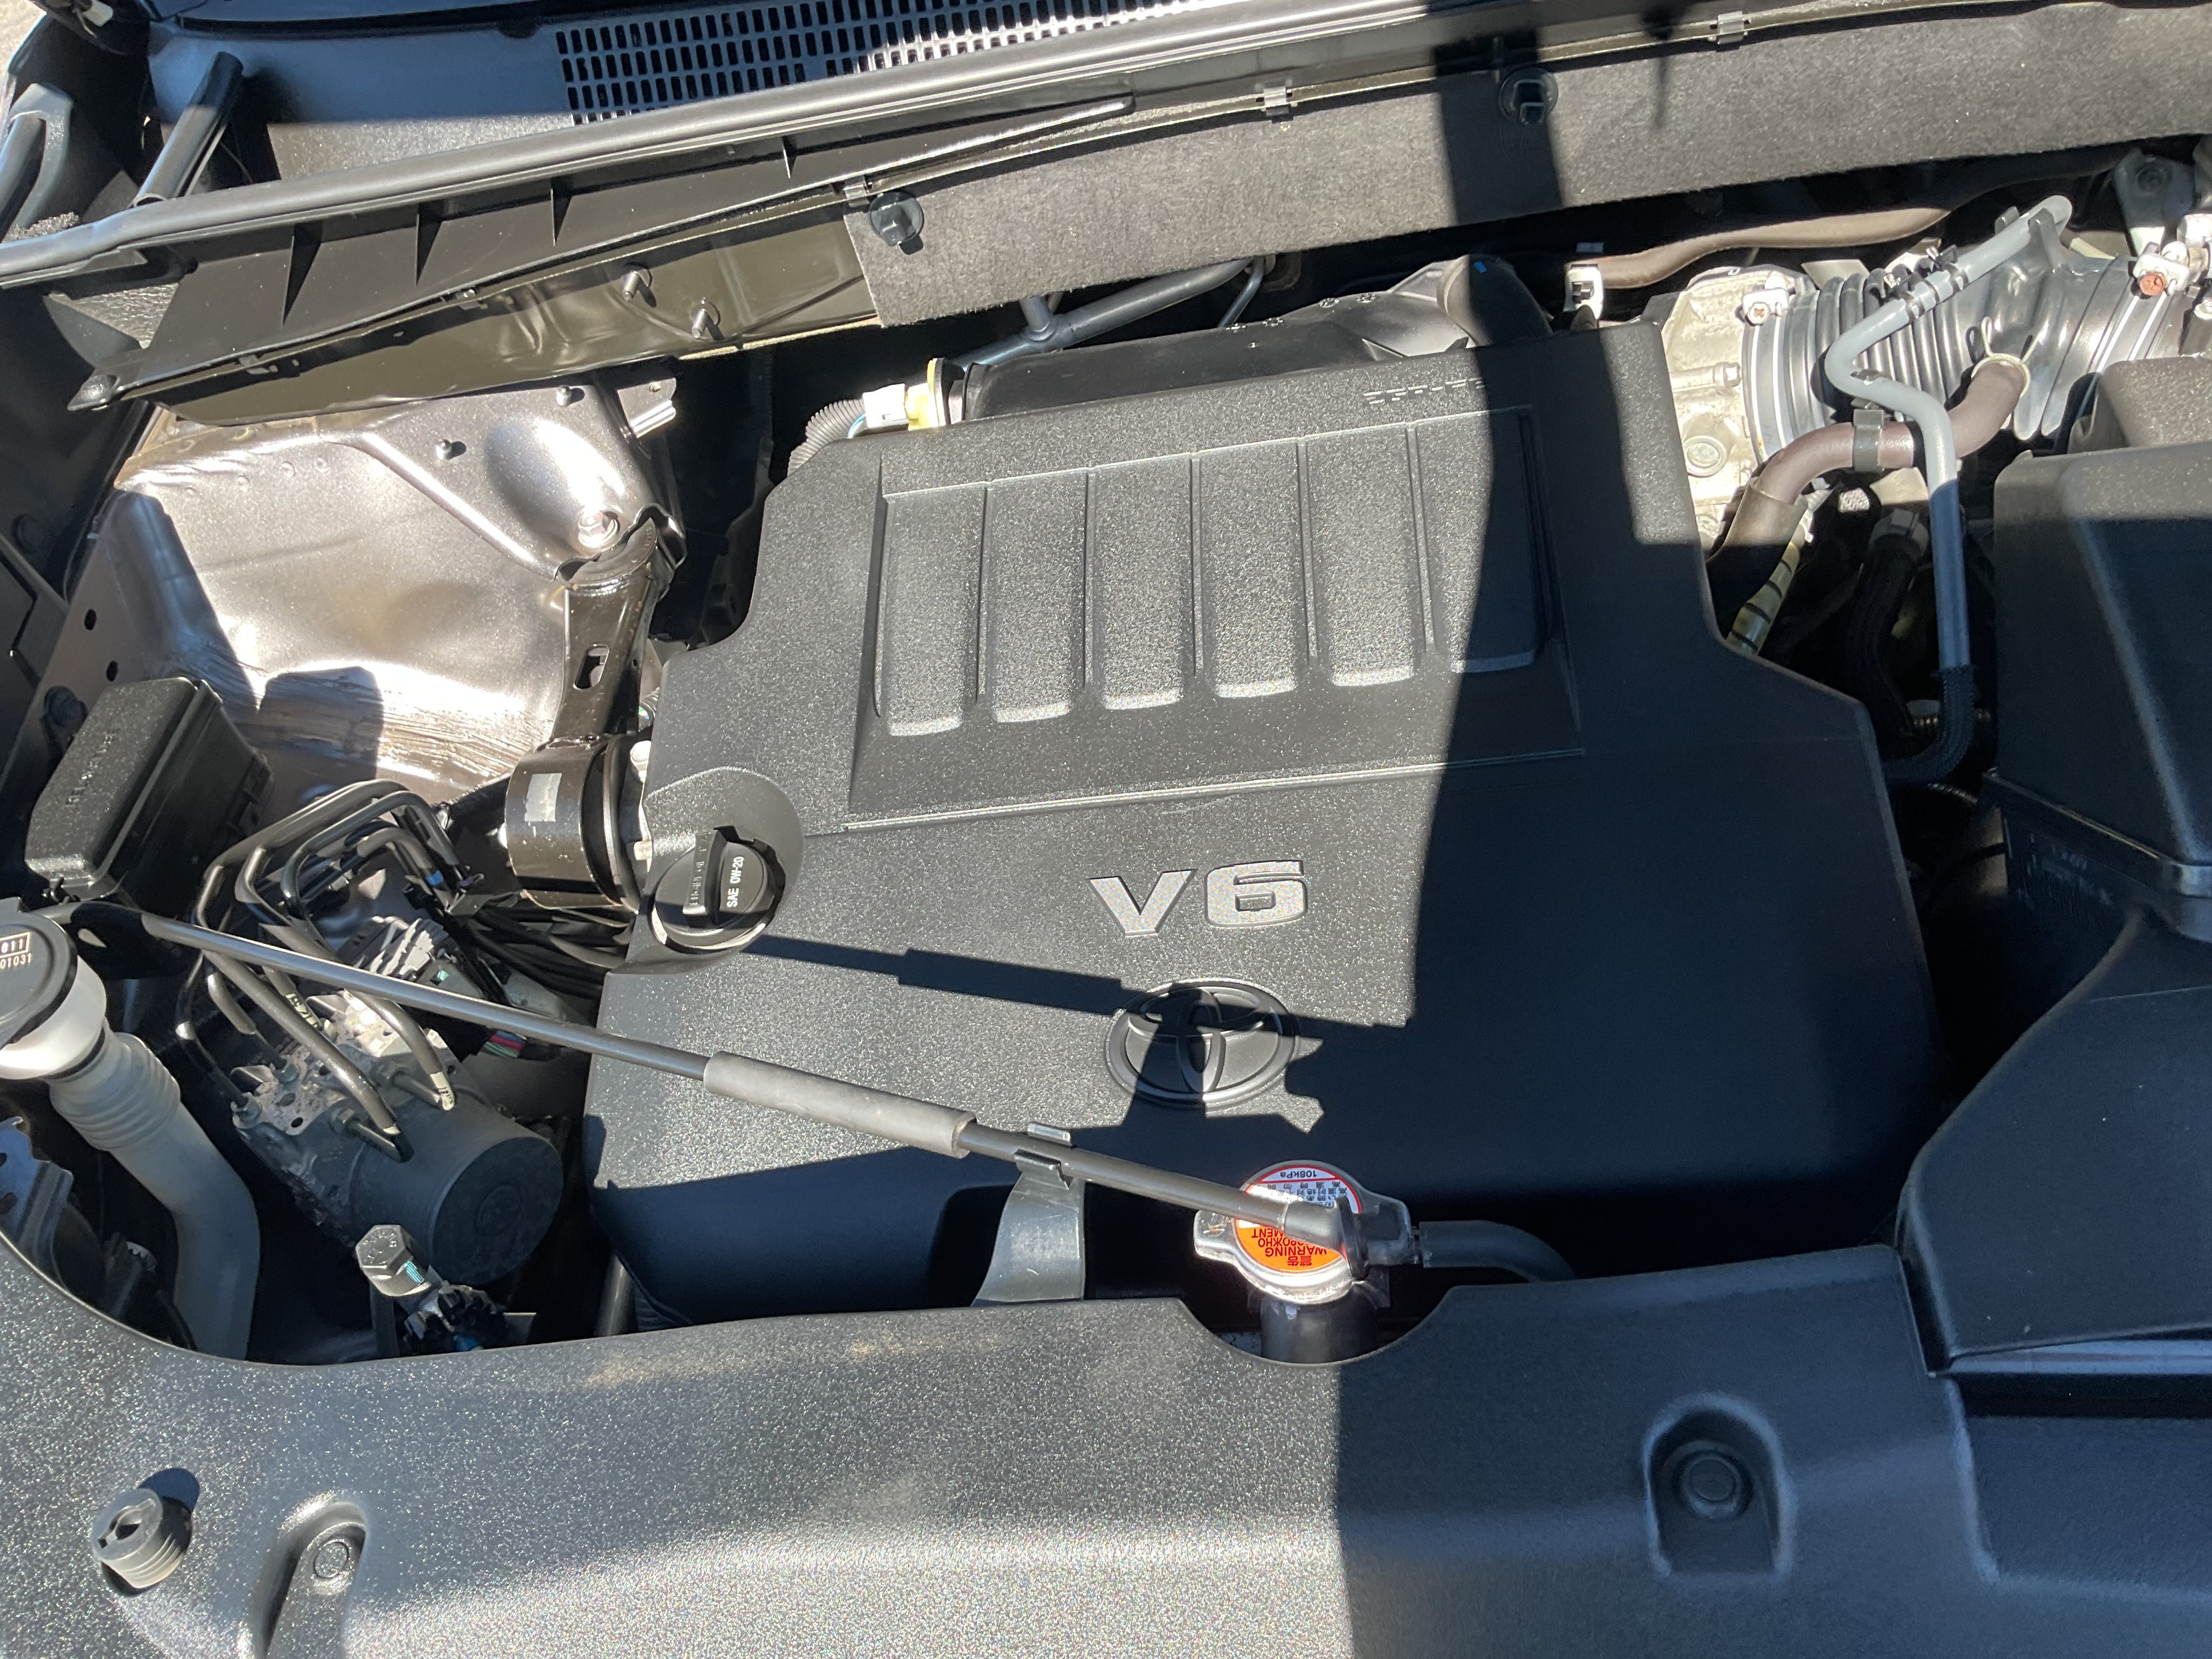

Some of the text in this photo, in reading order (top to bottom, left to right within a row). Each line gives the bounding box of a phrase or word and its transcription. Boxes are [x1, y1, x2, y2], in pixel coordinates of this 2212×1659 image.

[726, 888, 739, 907] SAE
[1089, 860, 1309, 936] V6
[1280, 1170, 1317, 1178] 108kPa
[1265, 1246, 1327, 1257] WARNING
